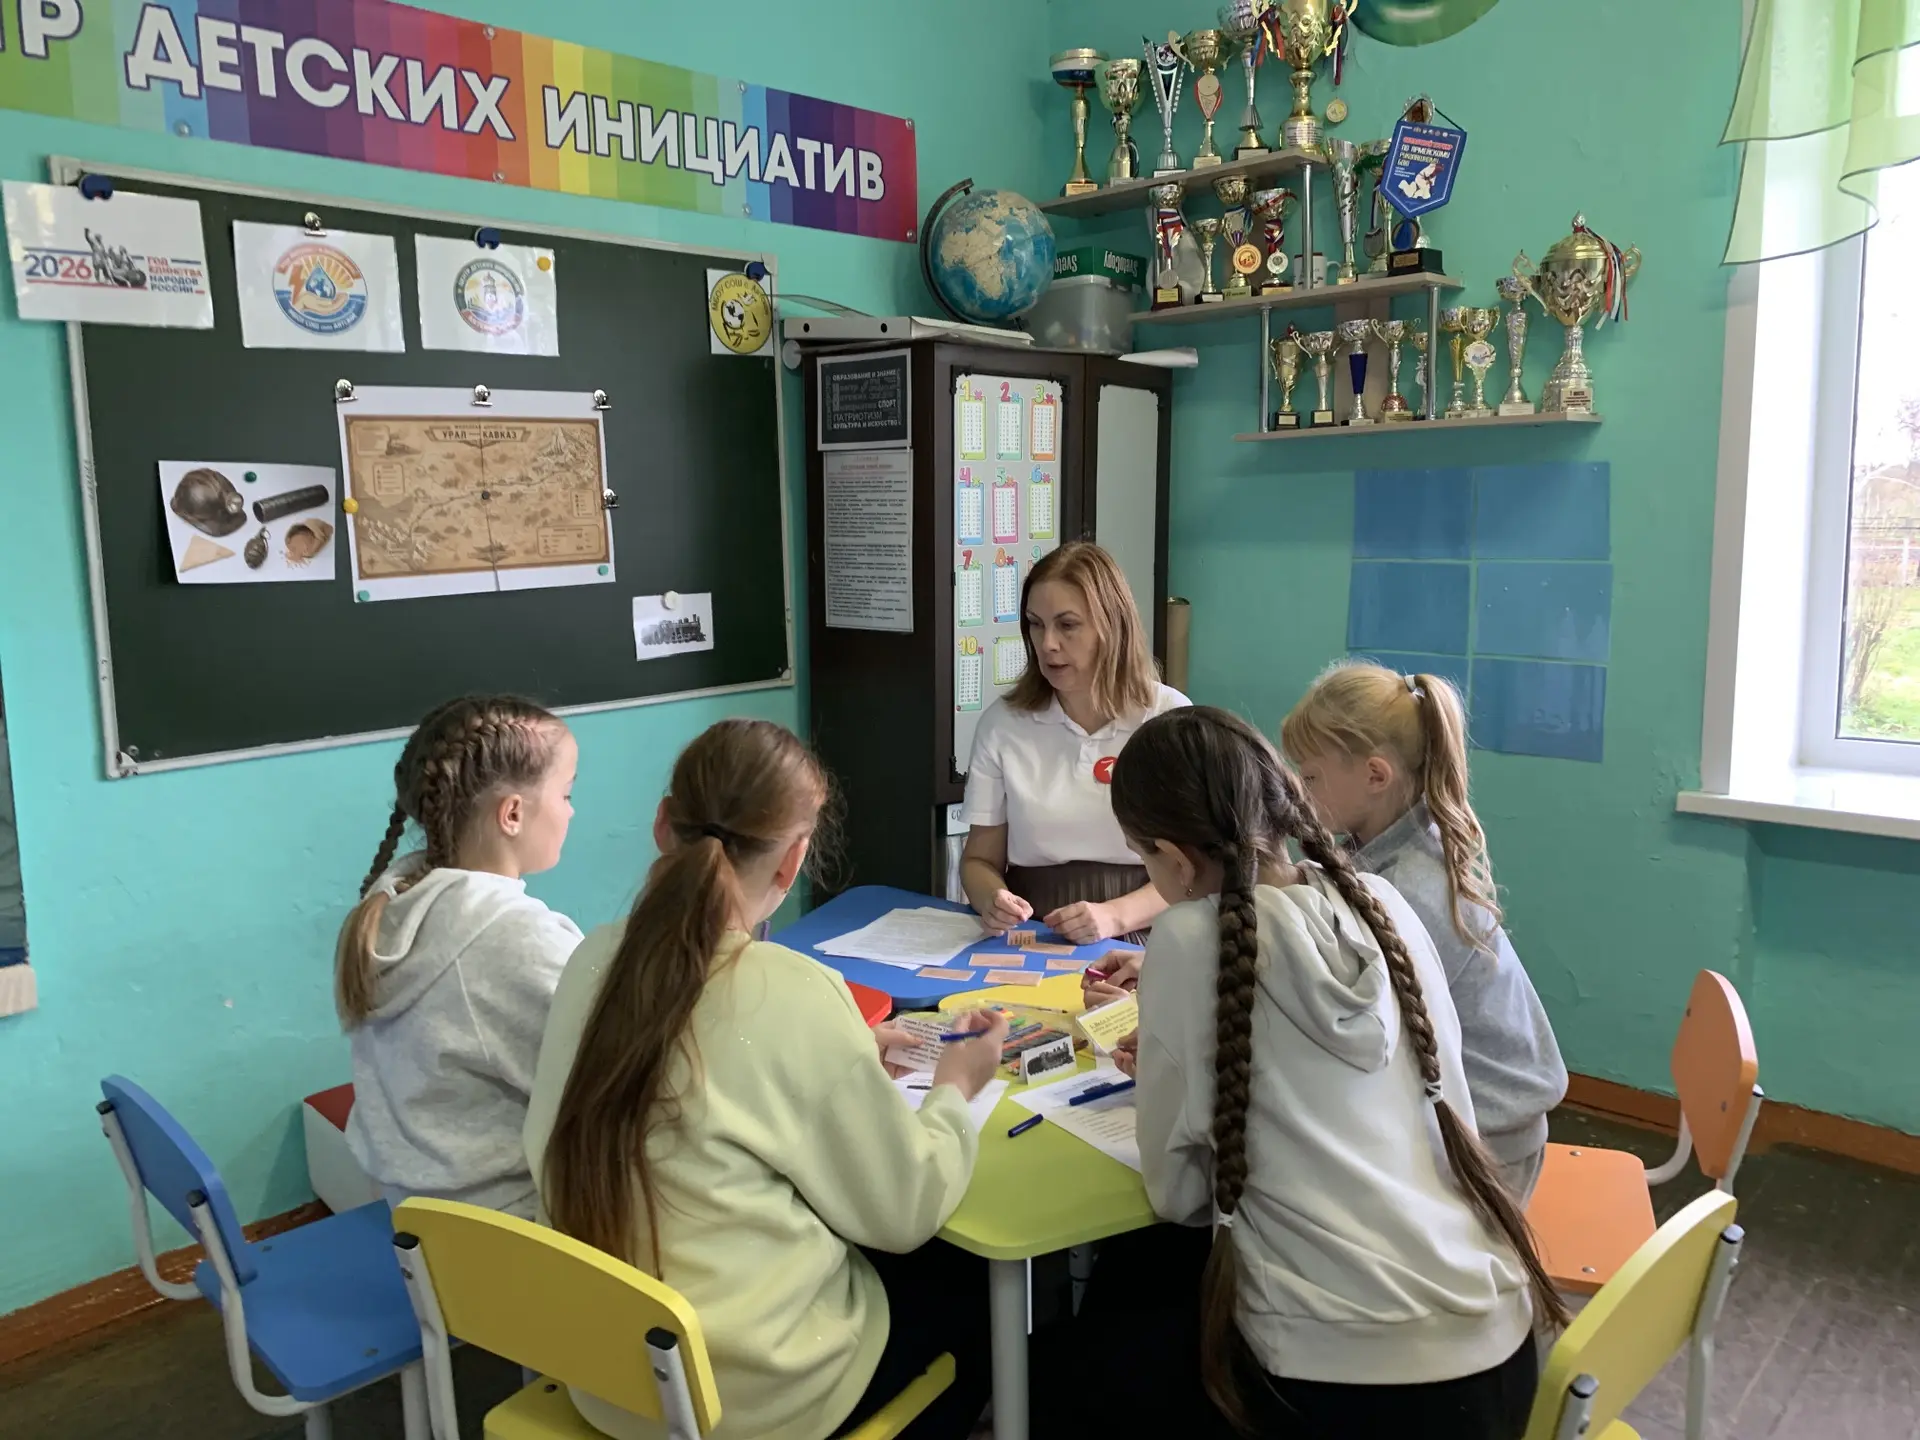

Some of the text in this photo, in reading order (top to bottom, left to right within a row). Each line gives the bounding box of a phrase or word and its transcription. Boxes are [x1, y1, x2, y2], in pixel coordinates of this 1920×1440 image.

[0, 0, 886, 201] Р ДЕТСКИХ ИНИЦИАТИВ
[23, 253, 92, 280] 2026
[147, 255, 169, 267] ГОД
[1103, 250, 1139, 278] SvetoCopy
[150, 275, 199, 286] НАРОДОВ
[151, 284, 194, 294] РОССИИ
[877, 399, 897, 409] СПОРТ
[832, 411, 883, 422] ПАТРИОТИЗМ
[832, 421, 862, 430] КУЛЬТУРА
[442, 430, 517, 439] УРАЛ КАВКАЗ
